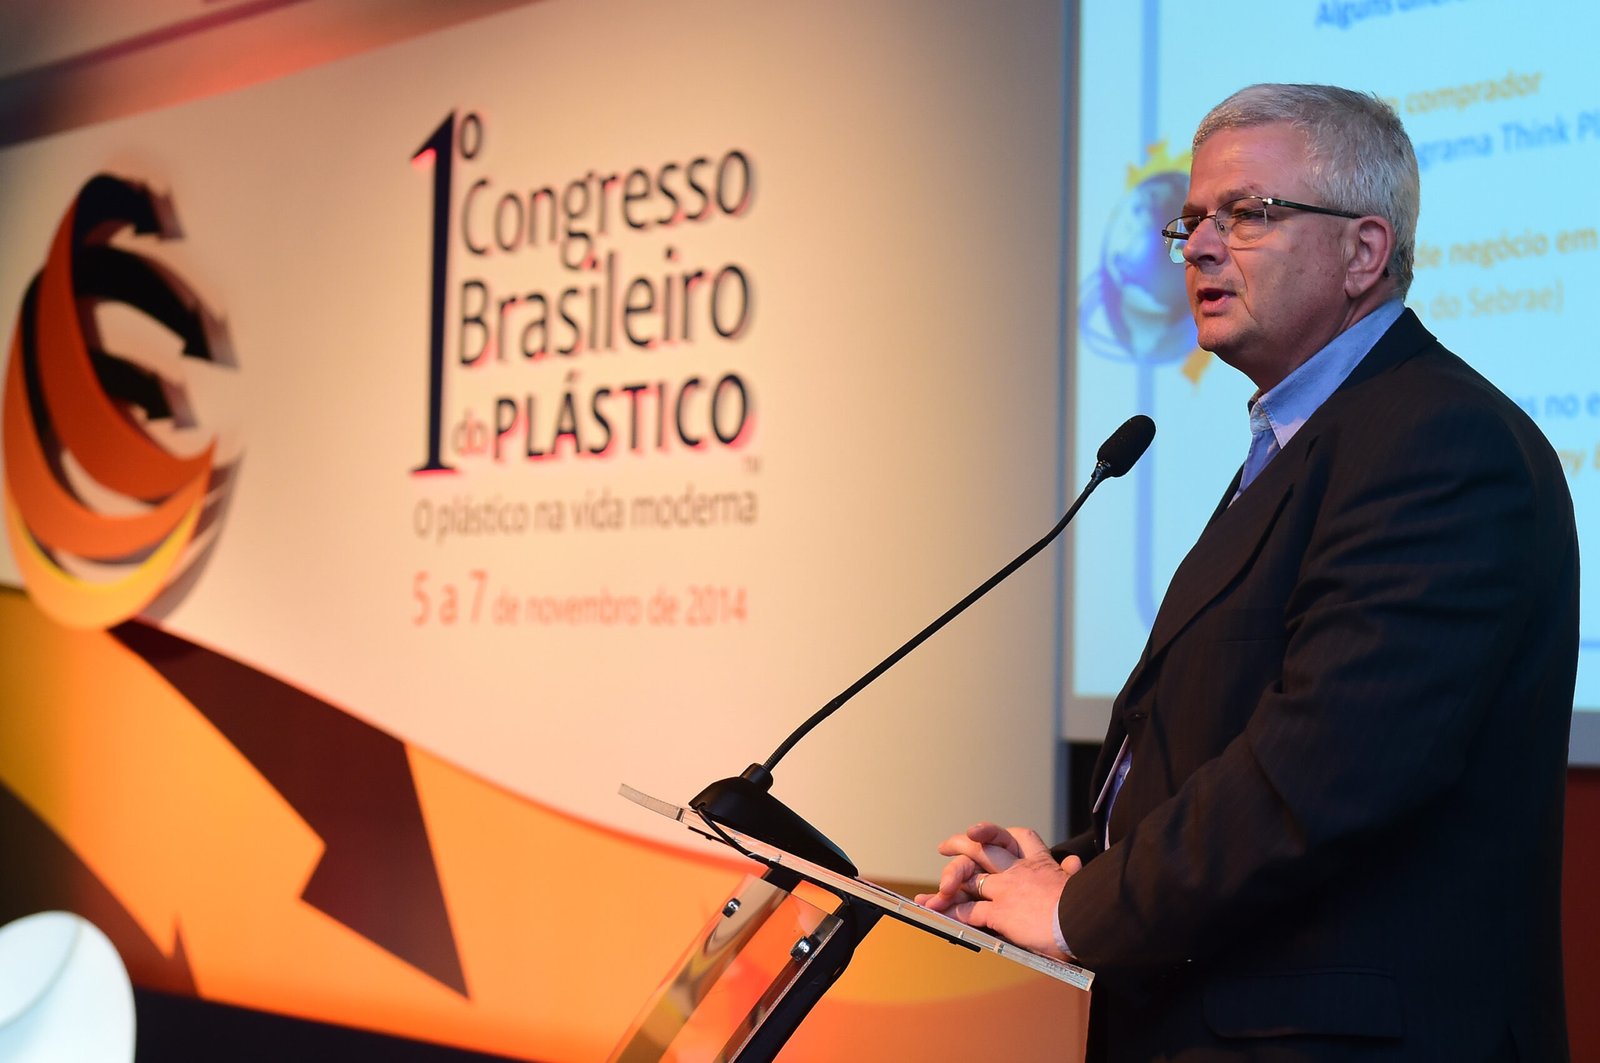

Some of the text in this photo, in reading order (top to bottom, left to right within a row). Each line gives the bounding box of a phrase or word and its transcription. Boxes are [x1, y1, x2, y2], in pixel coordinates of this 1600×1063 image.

[1406, 69, 1543, 115] comprador
[1416, 133, 1493, 171] grama
[1500, 114, 1570, 153] Think
[461, 148, 752, 271] Congresso
[1450, 229, 1548, 268] negócio
[1556, 227, 1598, 253] em
[459, 247, 752, 366] Brasileiro
[454, 369, 753, 461] do PLÁSTICO
[413, 481, 758, 546] O plástico na vida moderna
[412, 569, 748, 627] 5 a 7 de novembro de 2014
